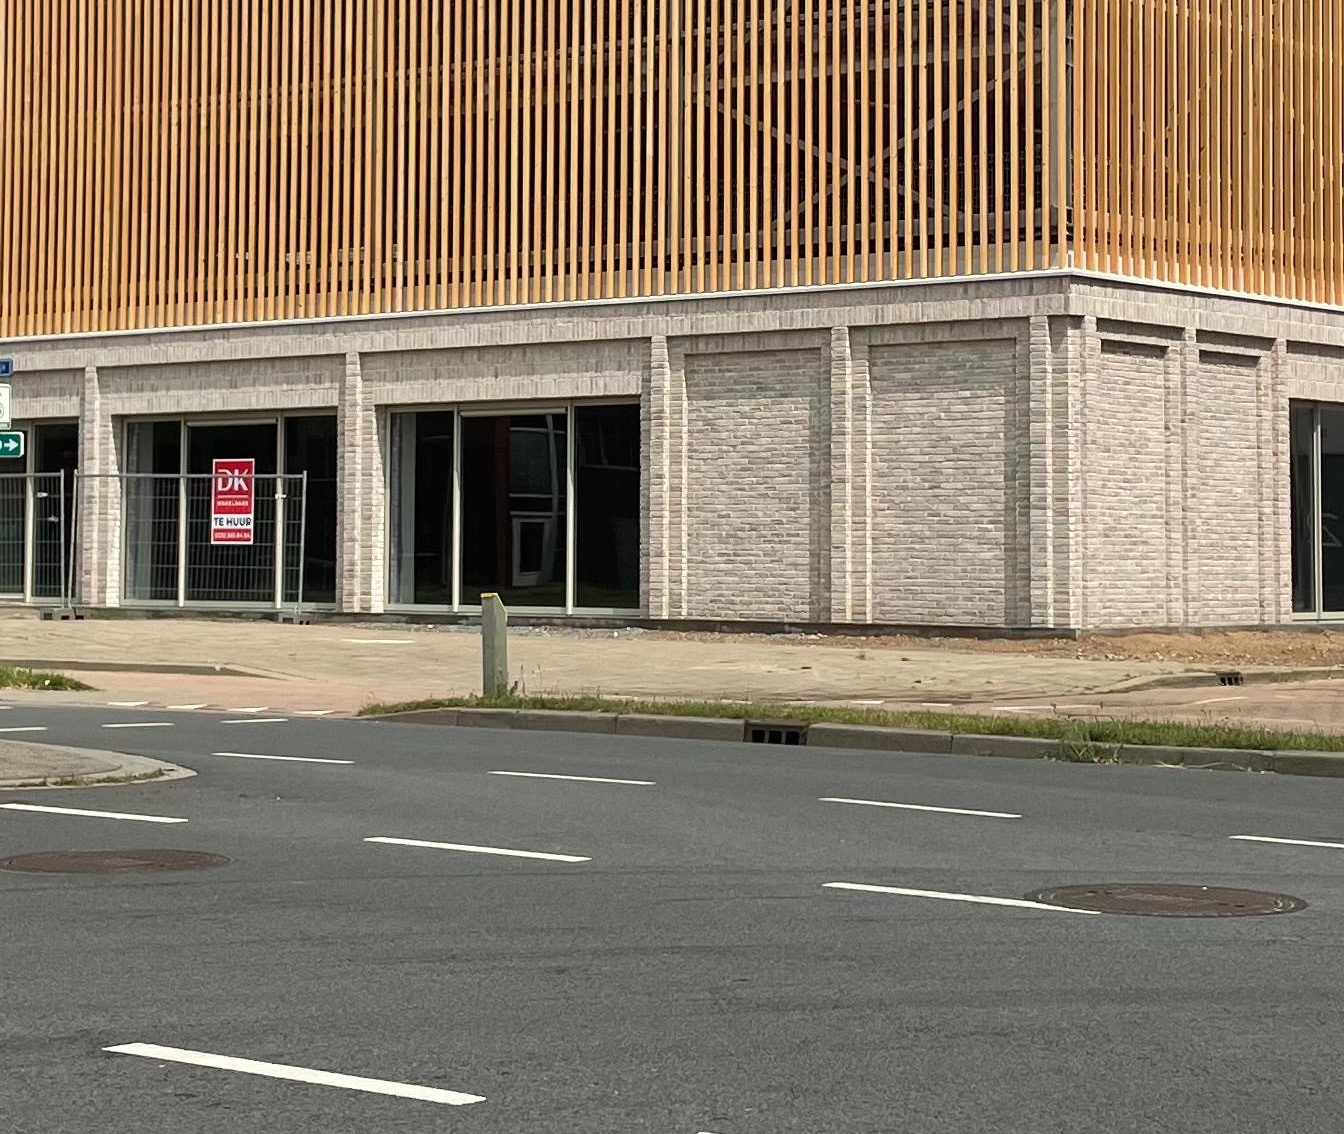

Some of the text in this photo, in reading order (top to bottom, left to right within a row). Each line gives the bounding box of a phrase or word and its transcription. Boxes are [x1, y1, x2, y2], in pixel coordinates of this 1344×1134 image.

[217, 469, 249, 492] DK
[214, 517, 252, 526] TE HUUR
